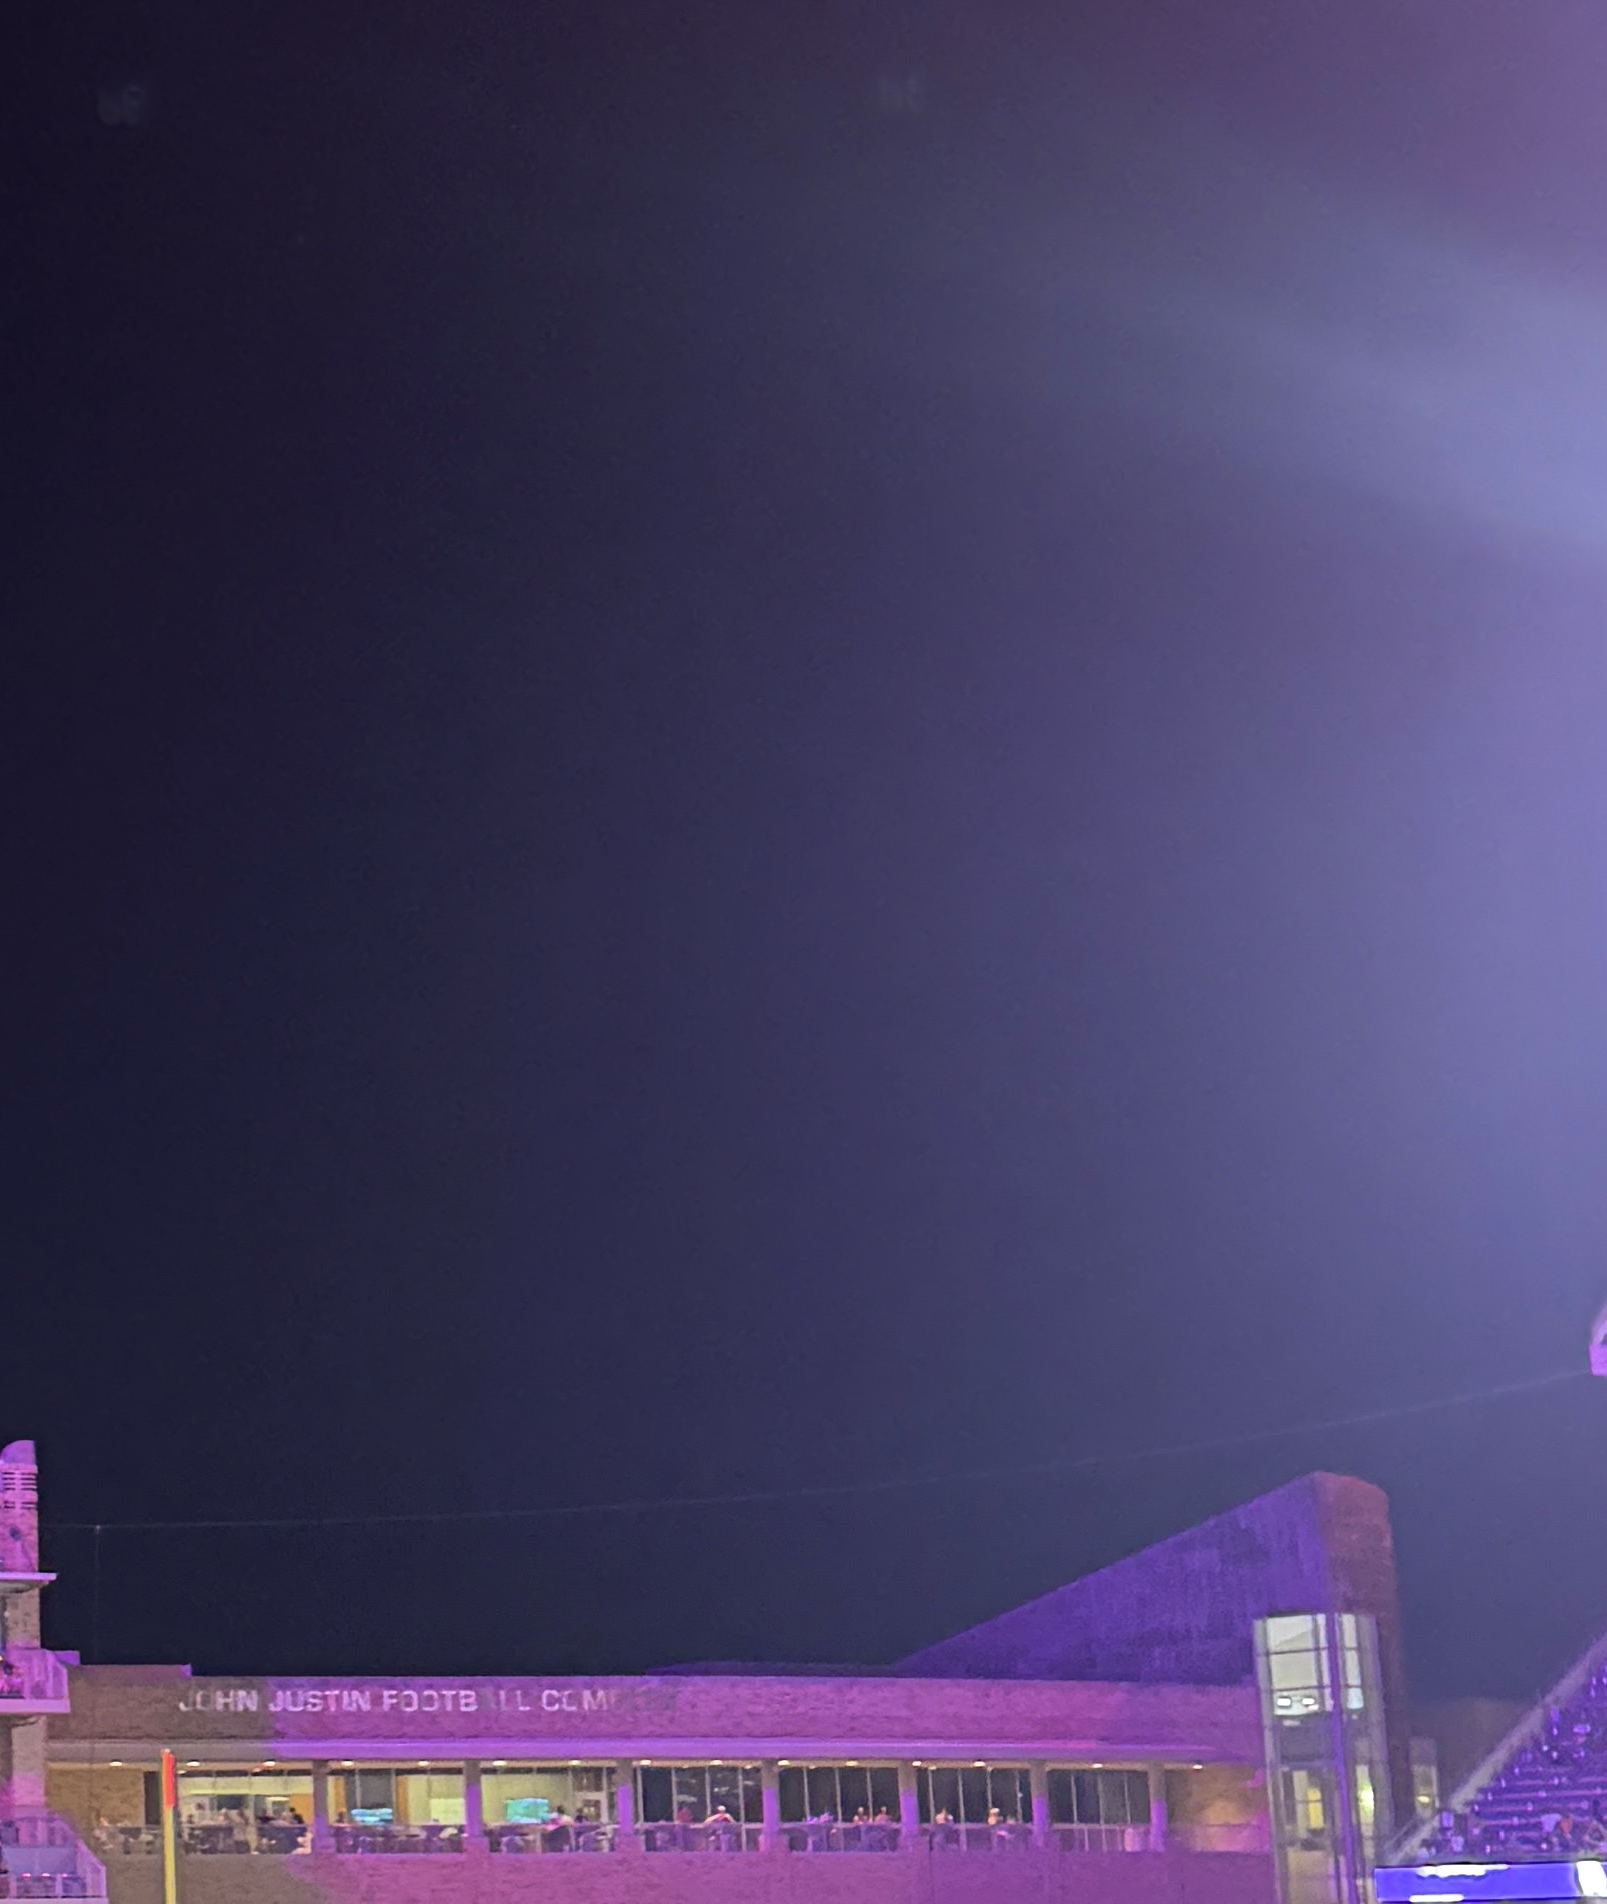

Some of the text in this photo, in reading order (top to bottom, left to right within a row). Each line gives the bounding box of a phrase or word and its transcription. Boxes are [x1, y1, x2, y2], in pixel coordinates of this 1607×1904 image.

[179, 1690, 258, 1712] JOHN
[268, 1690, 371, 1712] JUSTIN
[382, 1690, 531, 1712] FOOTBLL
